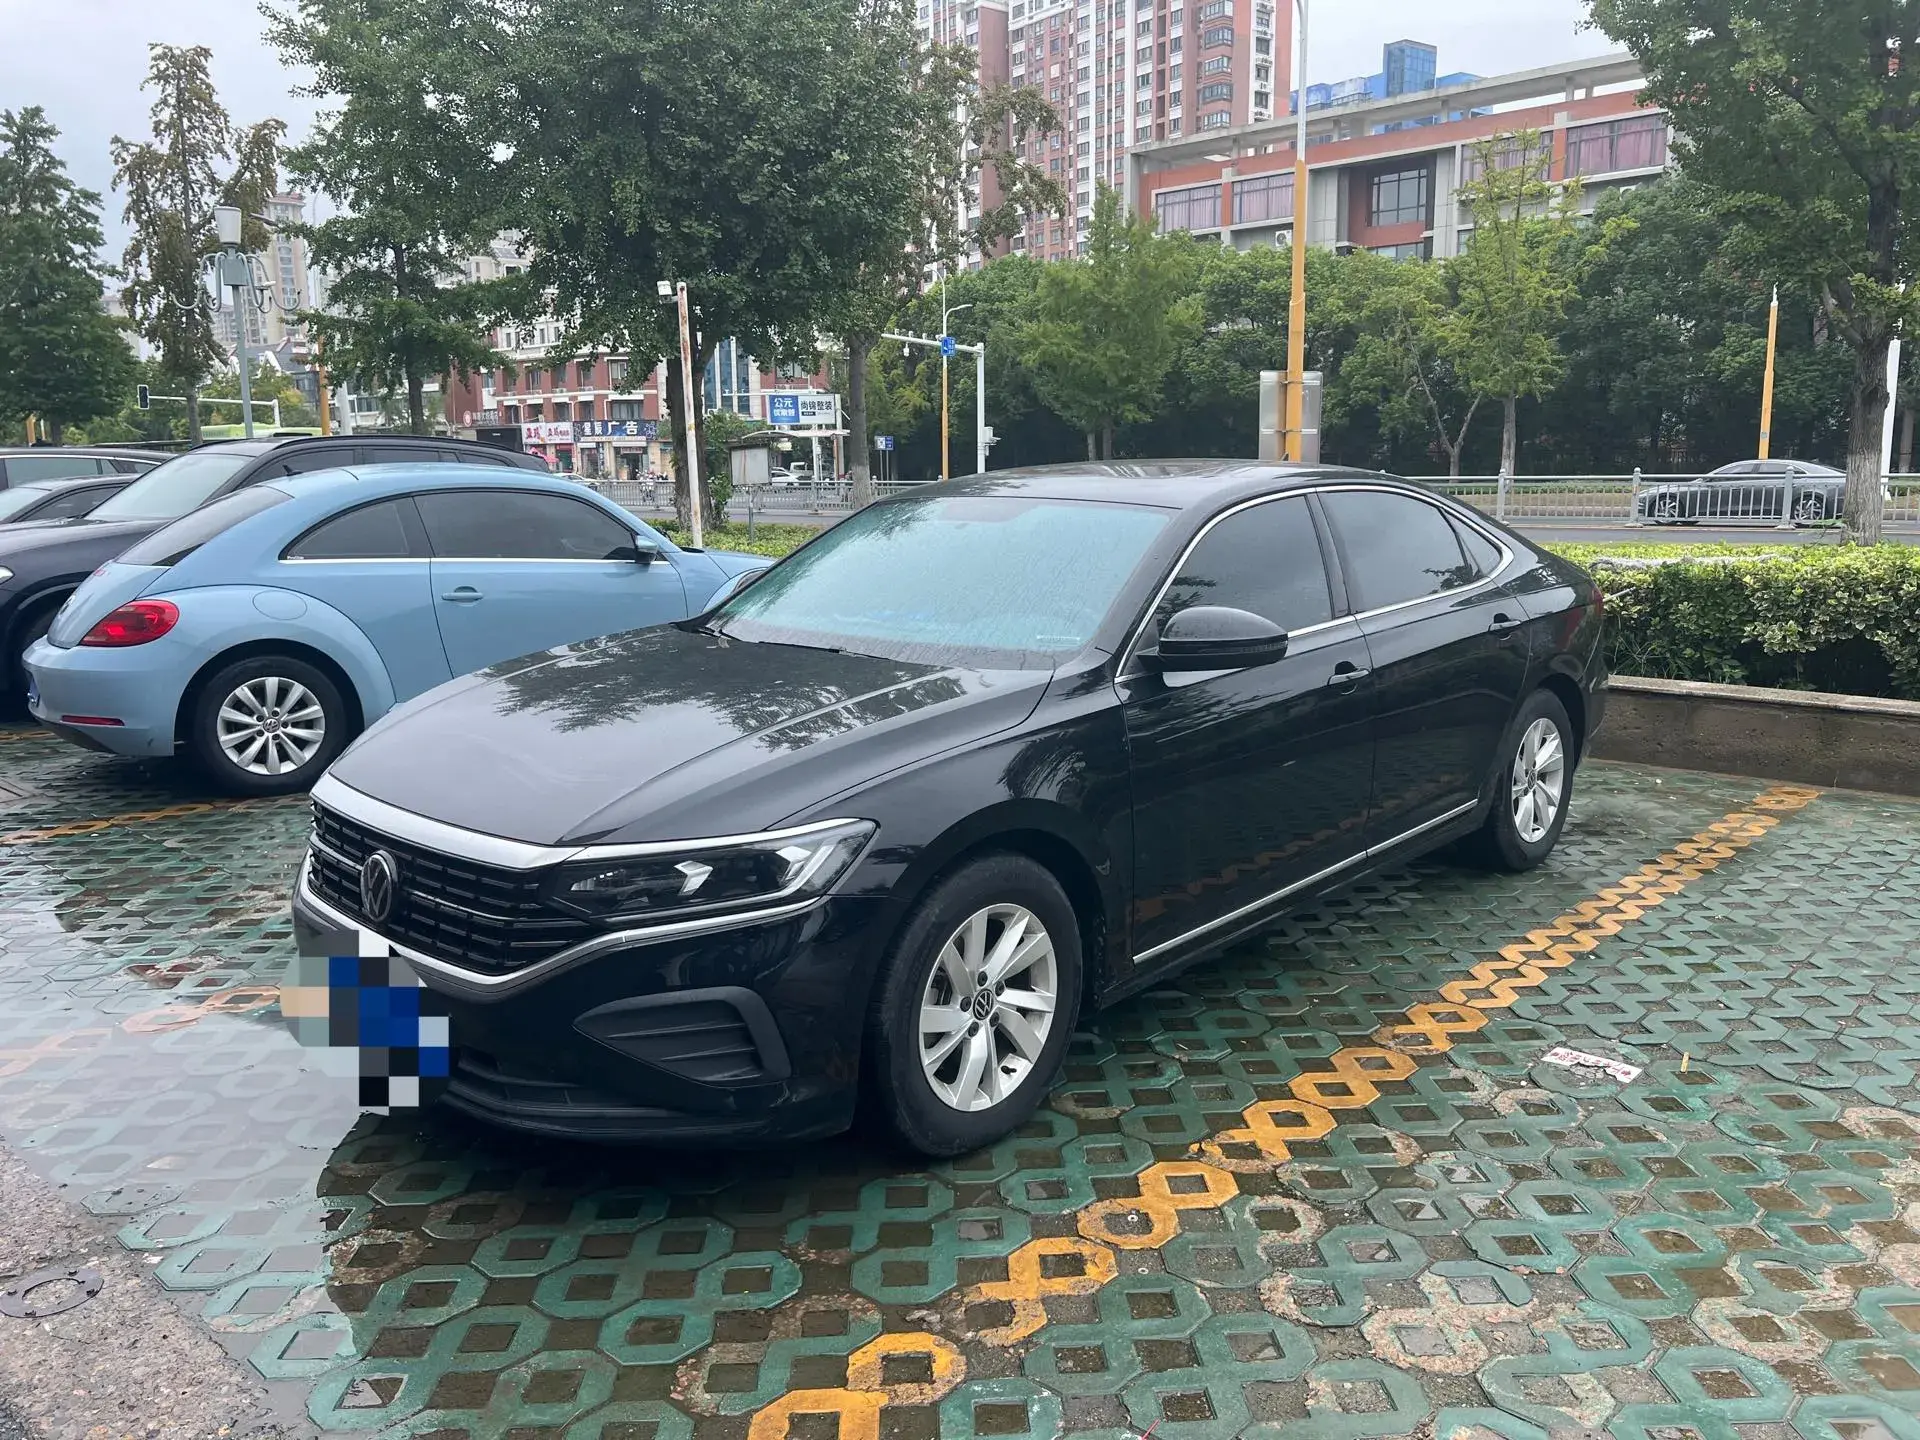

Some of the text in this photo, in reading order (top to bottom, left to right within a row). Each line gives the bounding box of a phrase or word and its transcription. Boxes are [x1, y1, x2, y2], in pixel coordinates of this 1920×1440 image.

[774, 397, 793, 408] 公元
[582, 420, 638, 436] 星辰广告
